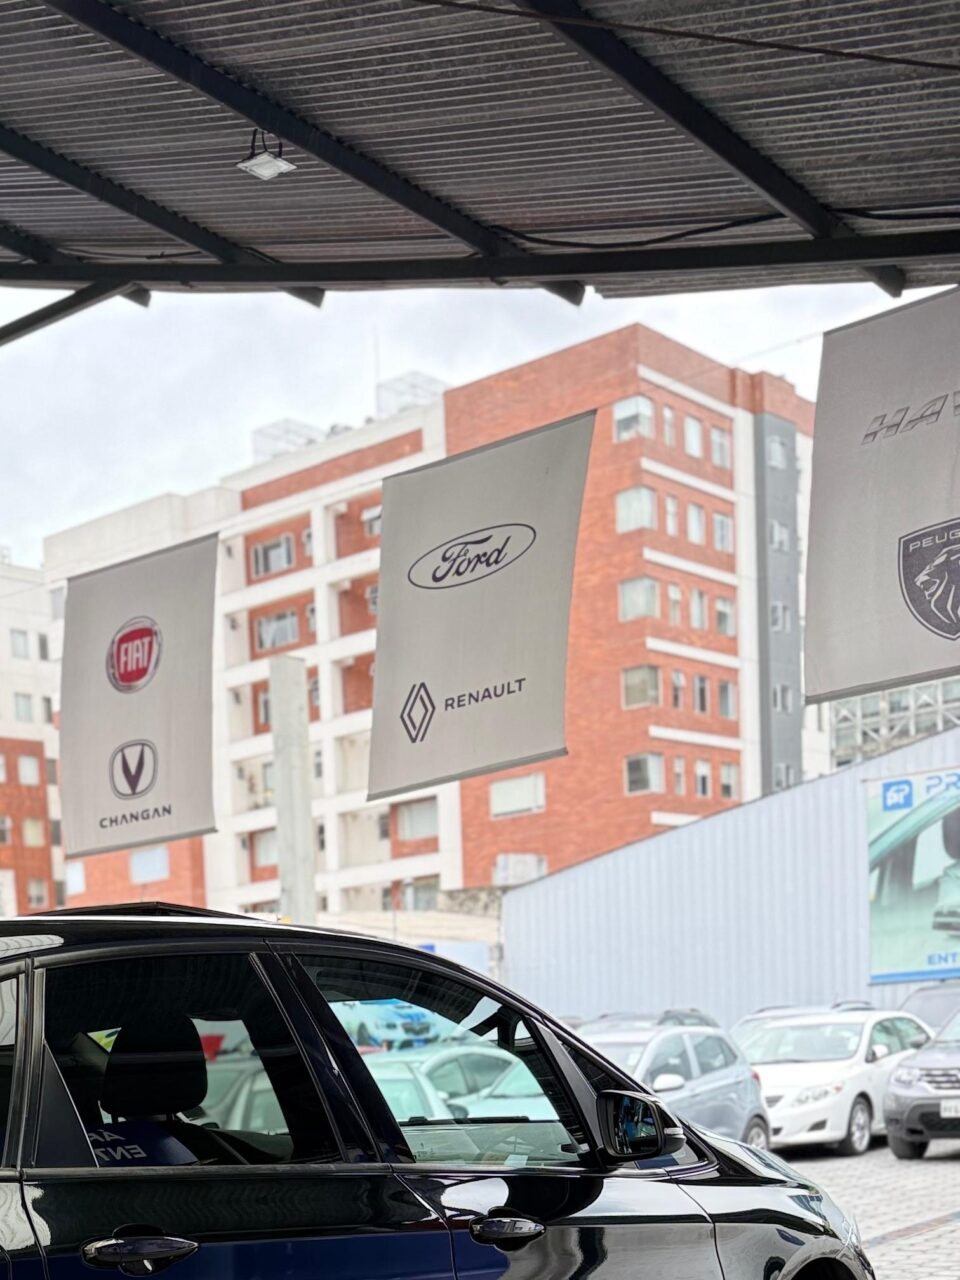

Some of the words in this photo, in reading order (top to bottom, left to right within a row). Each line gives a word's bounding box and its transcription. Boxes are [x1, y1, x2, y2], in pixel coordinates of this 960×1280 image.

[861, 389, 960, 445] HA
[431, 534, 512, 583] Ford
[119, 636, 152, 674] FIAT
[444, 677, 526, 712] RENAULT
[99, 803, 173, 829] CHANGAN
